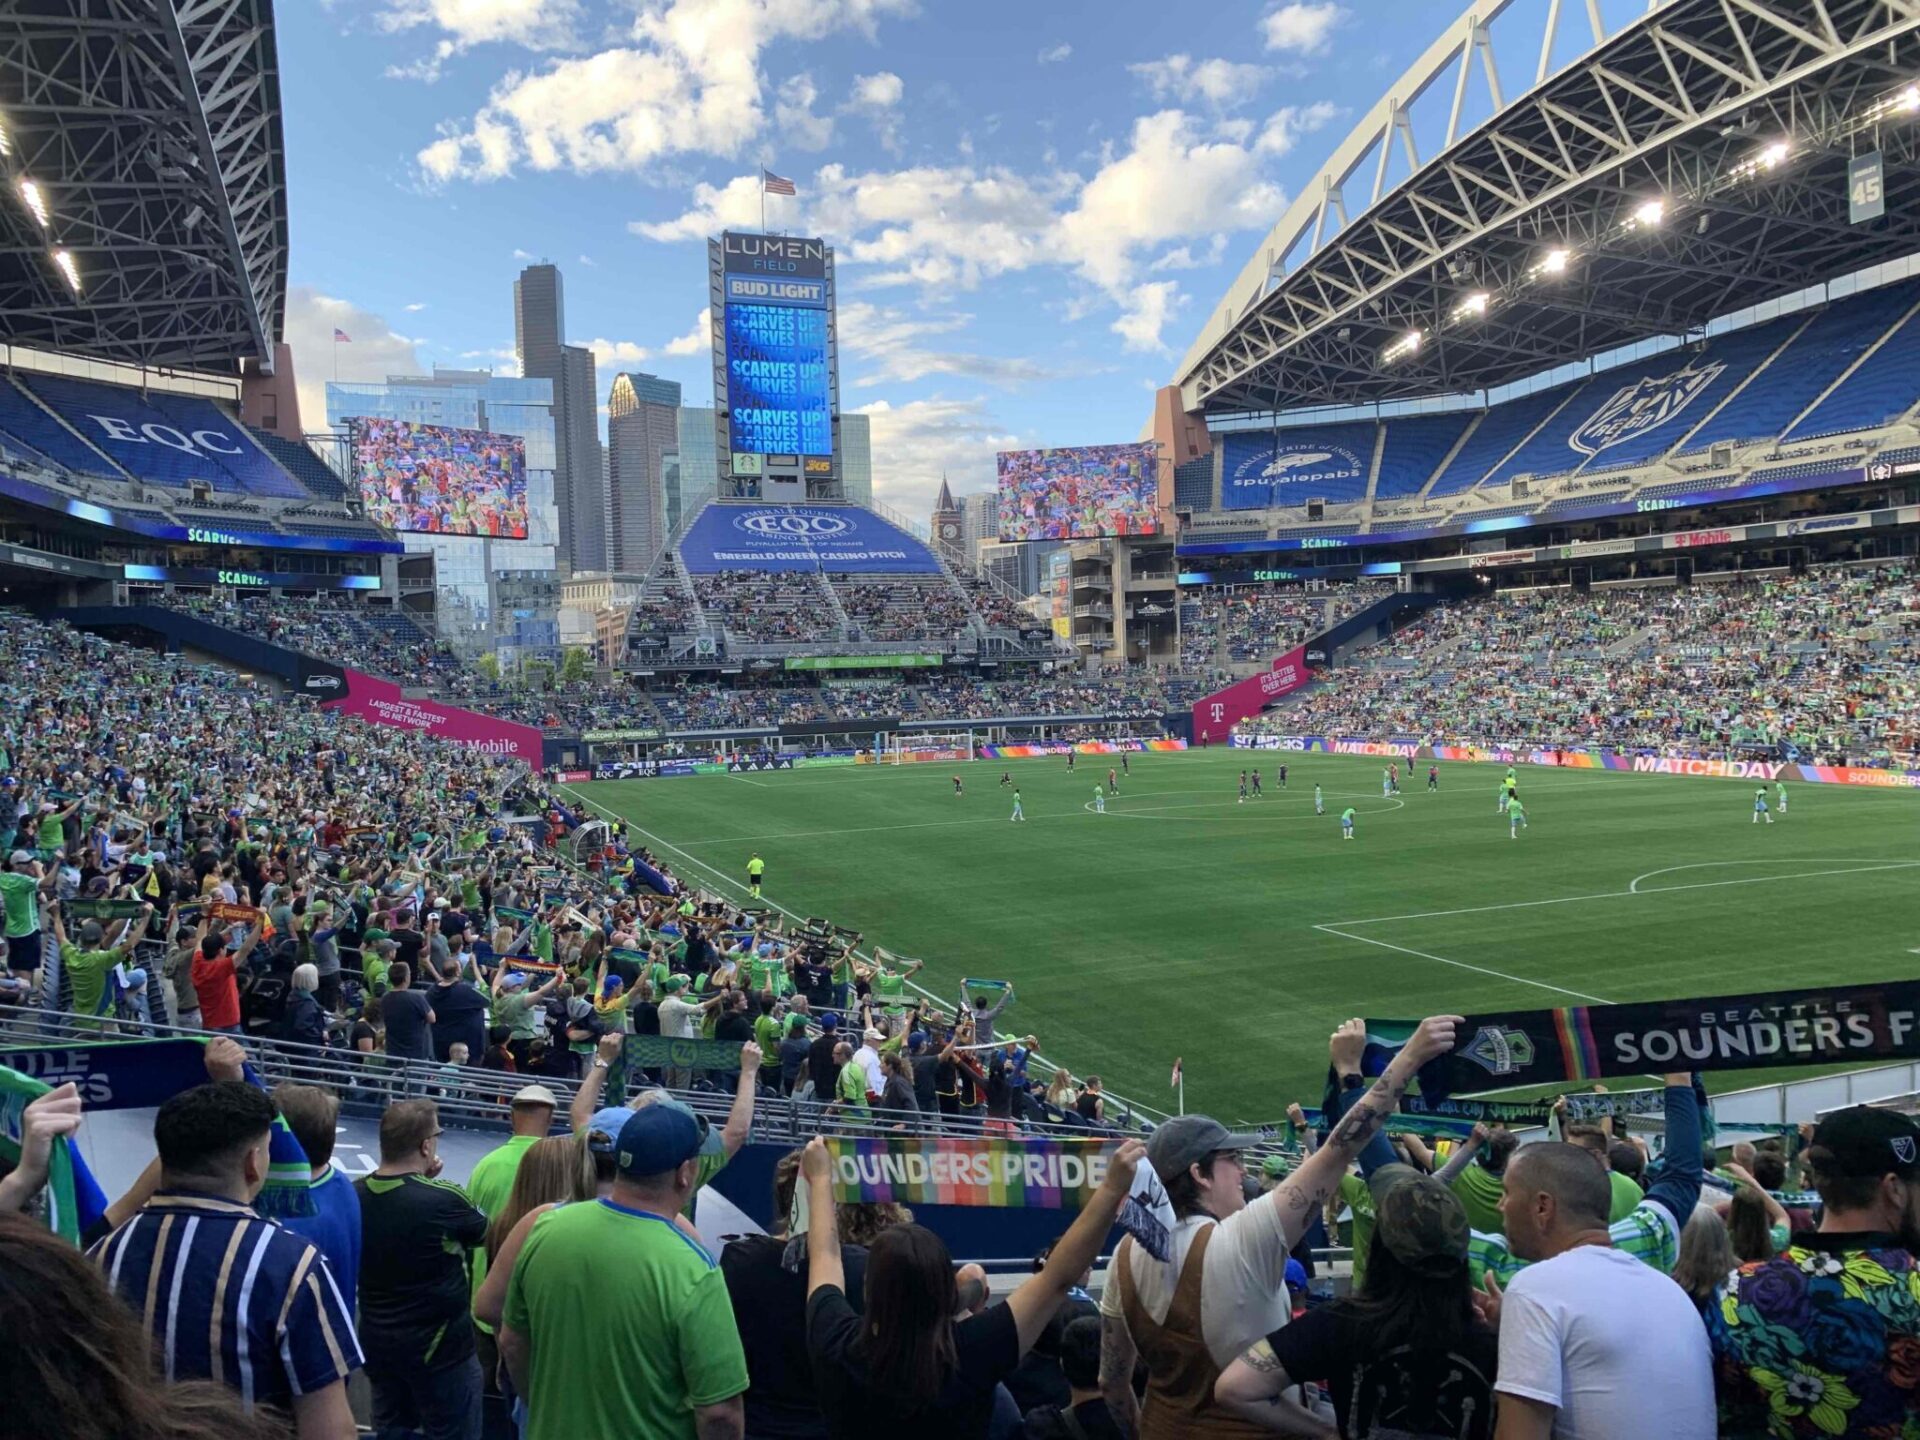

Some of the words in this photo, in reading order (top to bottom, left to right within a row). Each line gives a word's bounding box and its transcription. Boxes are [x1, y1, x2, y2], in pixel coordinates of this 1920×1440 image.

[1852, 176, 1880, 206] 45
[725, 237, 823, 260] LUMEN
[754, 260, 797, 272] FIELD
[731, 281, 768, 297] BUD
[771, 283, 820, 300] LIGHT
[731, 312, 794, 330] SCARVES
[732, 361, 796, 379] SCARVES
[734, 408, 799, 426] SCARVES
[86, 414, 243, 459] EQC
[1276, 444, 1316, 454] TRIBE
[742, 508, 796, 519] EMERALD
[800, 509, 841, 519] QUEEN
[760, 516, 838, 534] EQC
[748, 530, 798, 541] CASINO
[713, 552, 776, 560] EMERALD
[776, 552, 820, 560] QUEEN
[820, 552, 868, 560] CASINO
[868, 551, 906, 559] PITCH
[1260, 674, 1272, 684] IT'S
[1272, 664, 1296, 679] BETTER
[1262, 680, 1280, 692] OVER
[1281, 674, 1297, 686] HERE
[369, 698, 404, 714] LARGEST
[412, 710, 447, 724] FASTEST
[379, 710, 390, 718] 5G
[391, 712, 432, 728] NETWORK
[1110, 743, 1142, 751] DALLAS
[1334, 742, 1418, 758] MATCHDAY
[1502, 754, 1514, 762] FC
[1528, 755, 1538, 763] FC
[596, 770, 614, 780] EQC
[638, 768, 656, 777] EQC
[1633, 756, 1784, 780] MATCHDAY
[1700, 1001, 1852, 1024] SEATTLE
[1616, 1013, 1874, 1063] SOUNDERS
[1004, 1154, 1108, 1189] PRIDE
